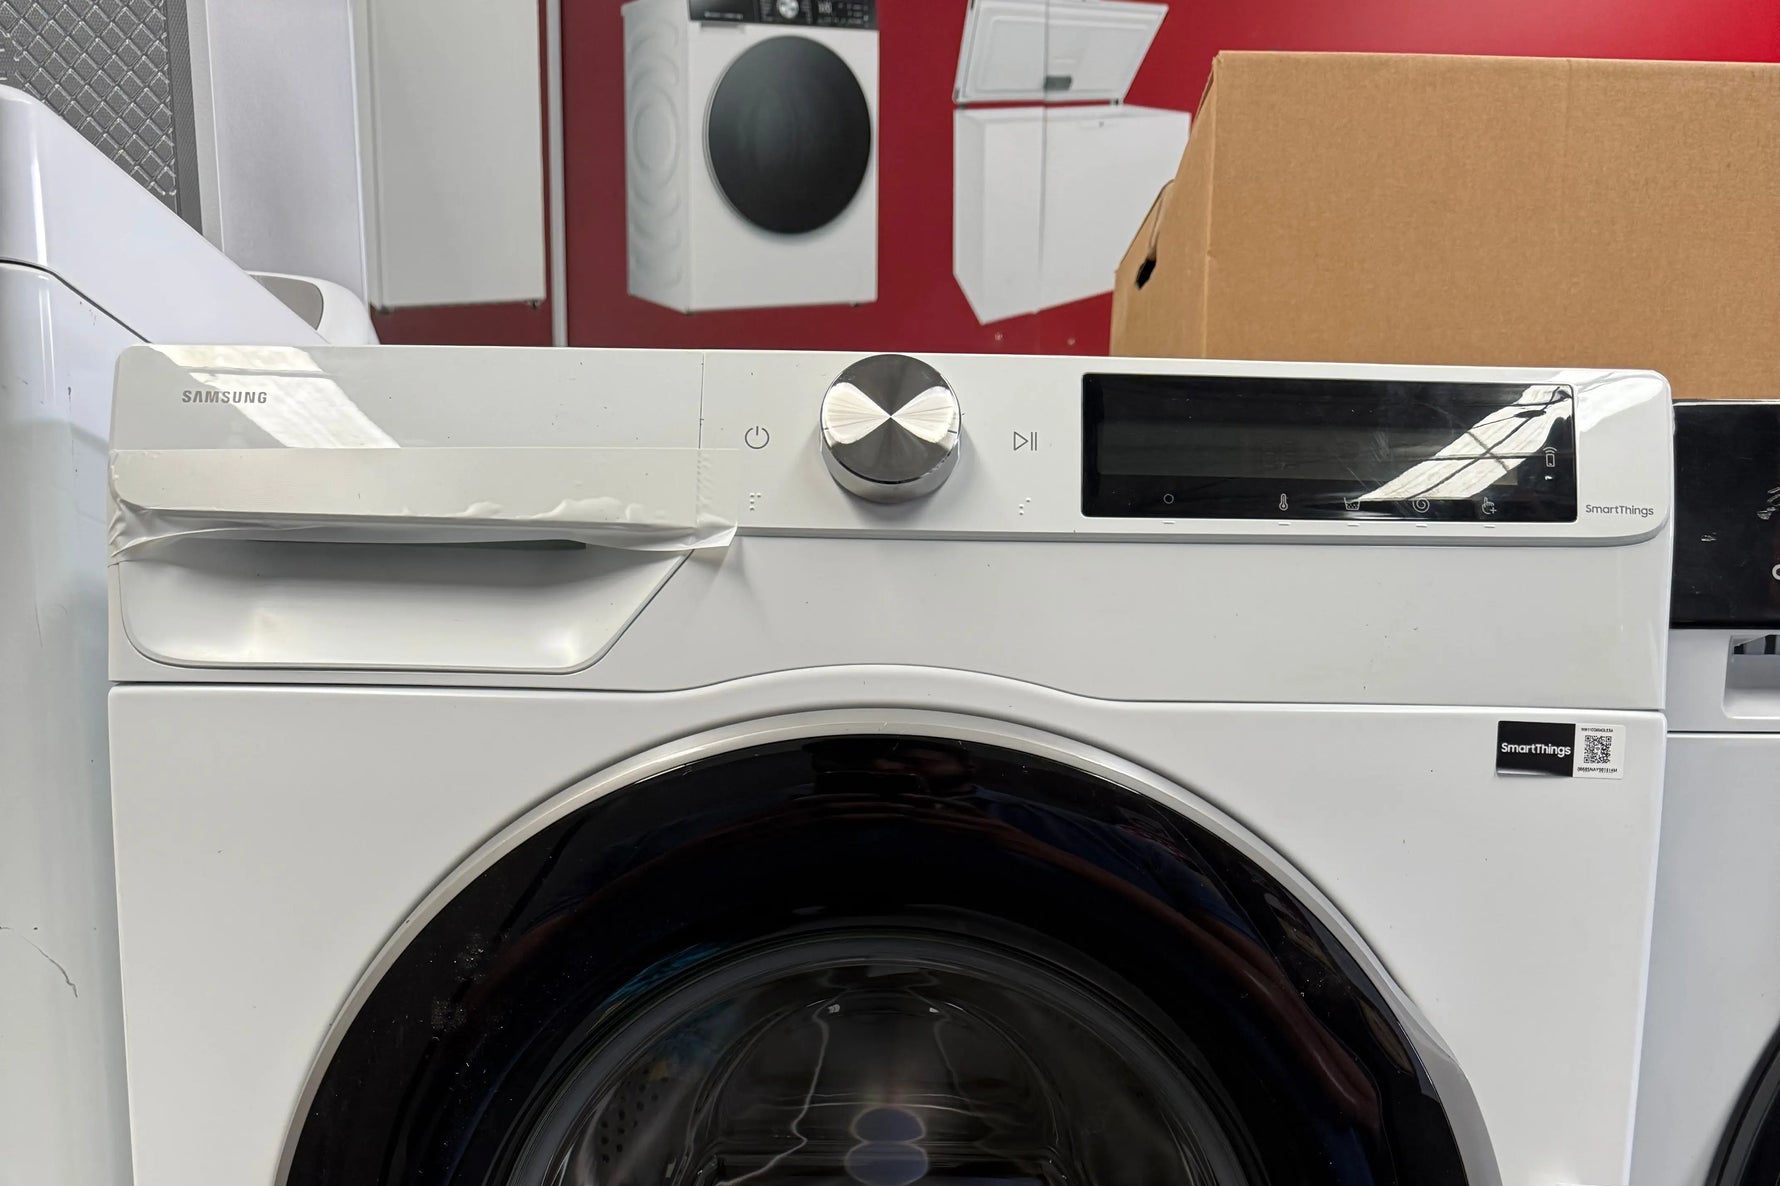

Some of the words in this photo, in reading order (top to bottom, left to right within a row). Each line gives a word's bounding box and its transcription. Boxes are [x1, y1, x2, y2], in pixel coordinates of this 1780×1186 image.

[182, 390, 268, 404] SAMSUNG
[1585, 504, 1654, 518] SmartThings
[1501, 742, 1571, 758] SmartThings
